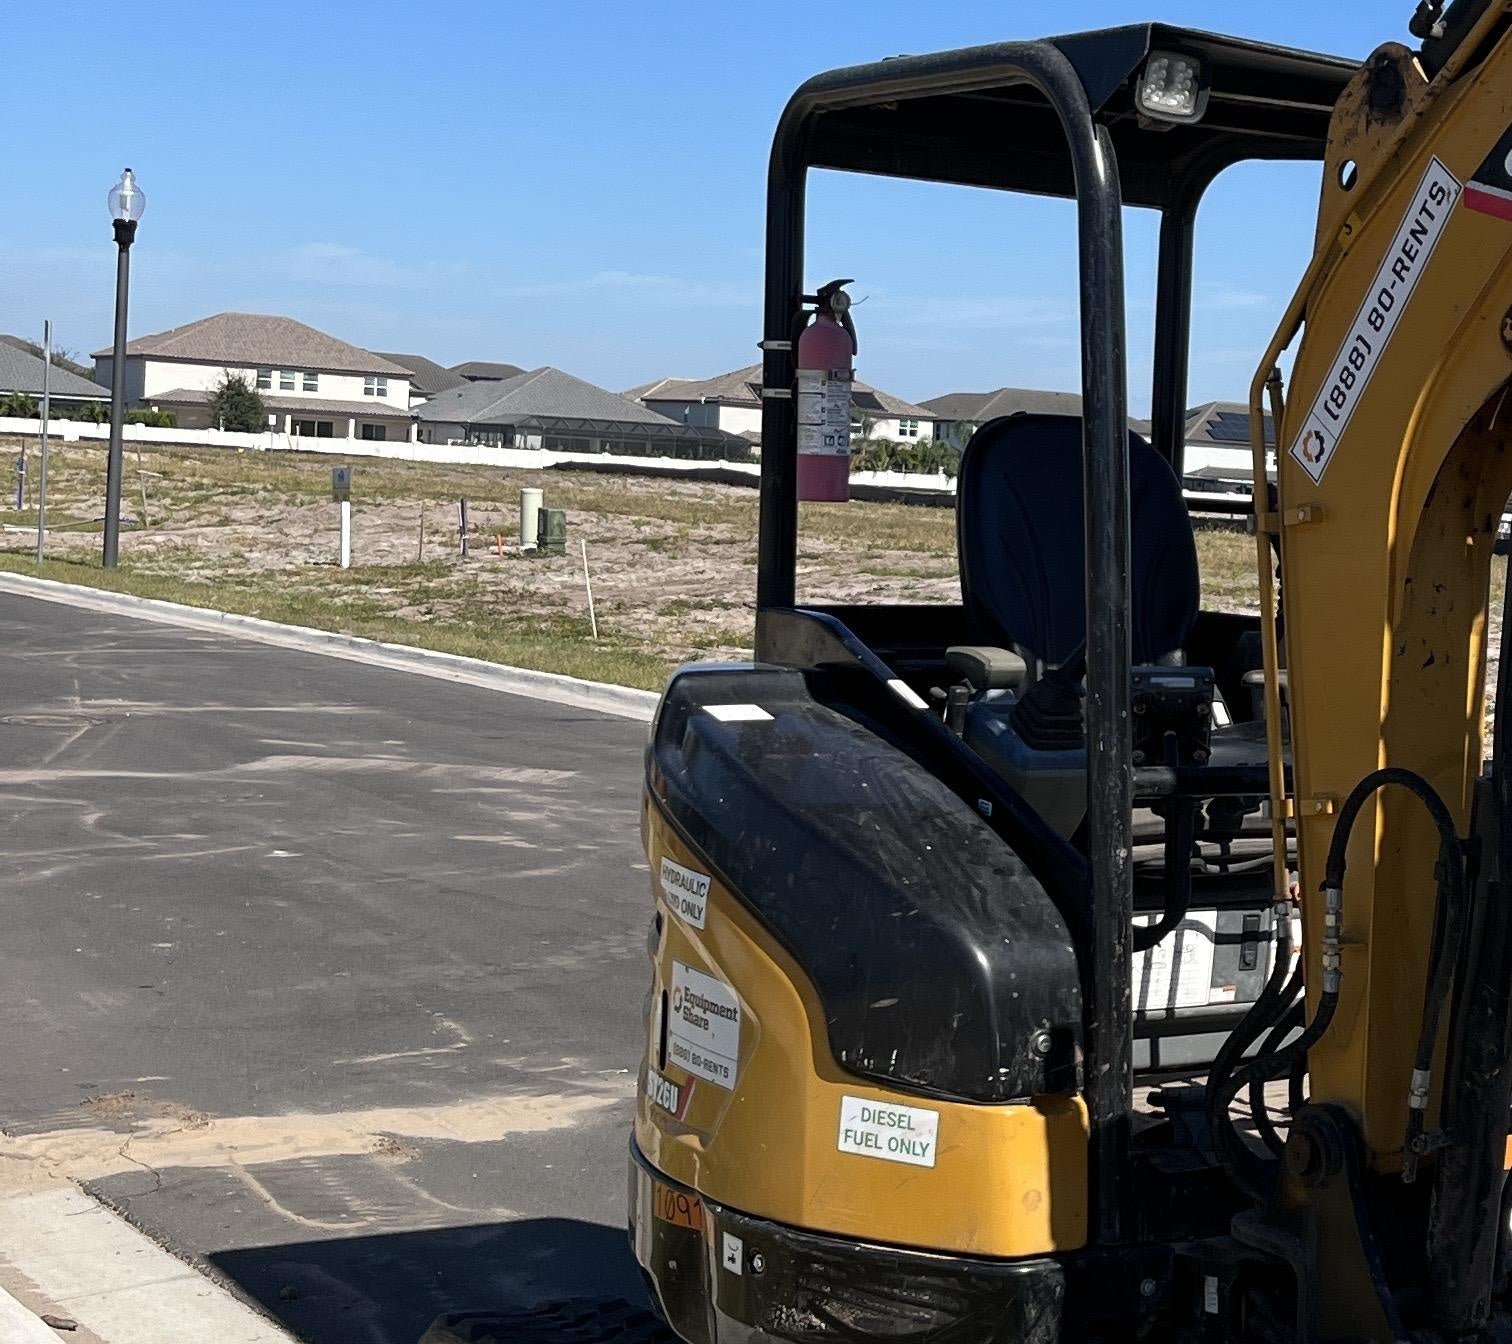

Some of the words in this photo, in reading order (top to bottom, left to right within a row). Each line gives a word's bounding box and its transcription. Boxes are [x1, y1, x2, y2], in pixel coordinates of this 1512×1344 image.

[1323, 334, 1372, 422] (888)
[1367, 180, 1447, 333] 80-RENTS
[662, 865, 707, 898] HYDRAULIC
[681, 899, 704, 922] ONLY
[682, 1005, 709, 1031] Share
[684, 986, 739, 1023] Equipment
[861, 1106, 916, 1131] DIESEL
[843, 1128, 884, 1150] FUEL
[887, 1136, 931, 1158] ONLY
